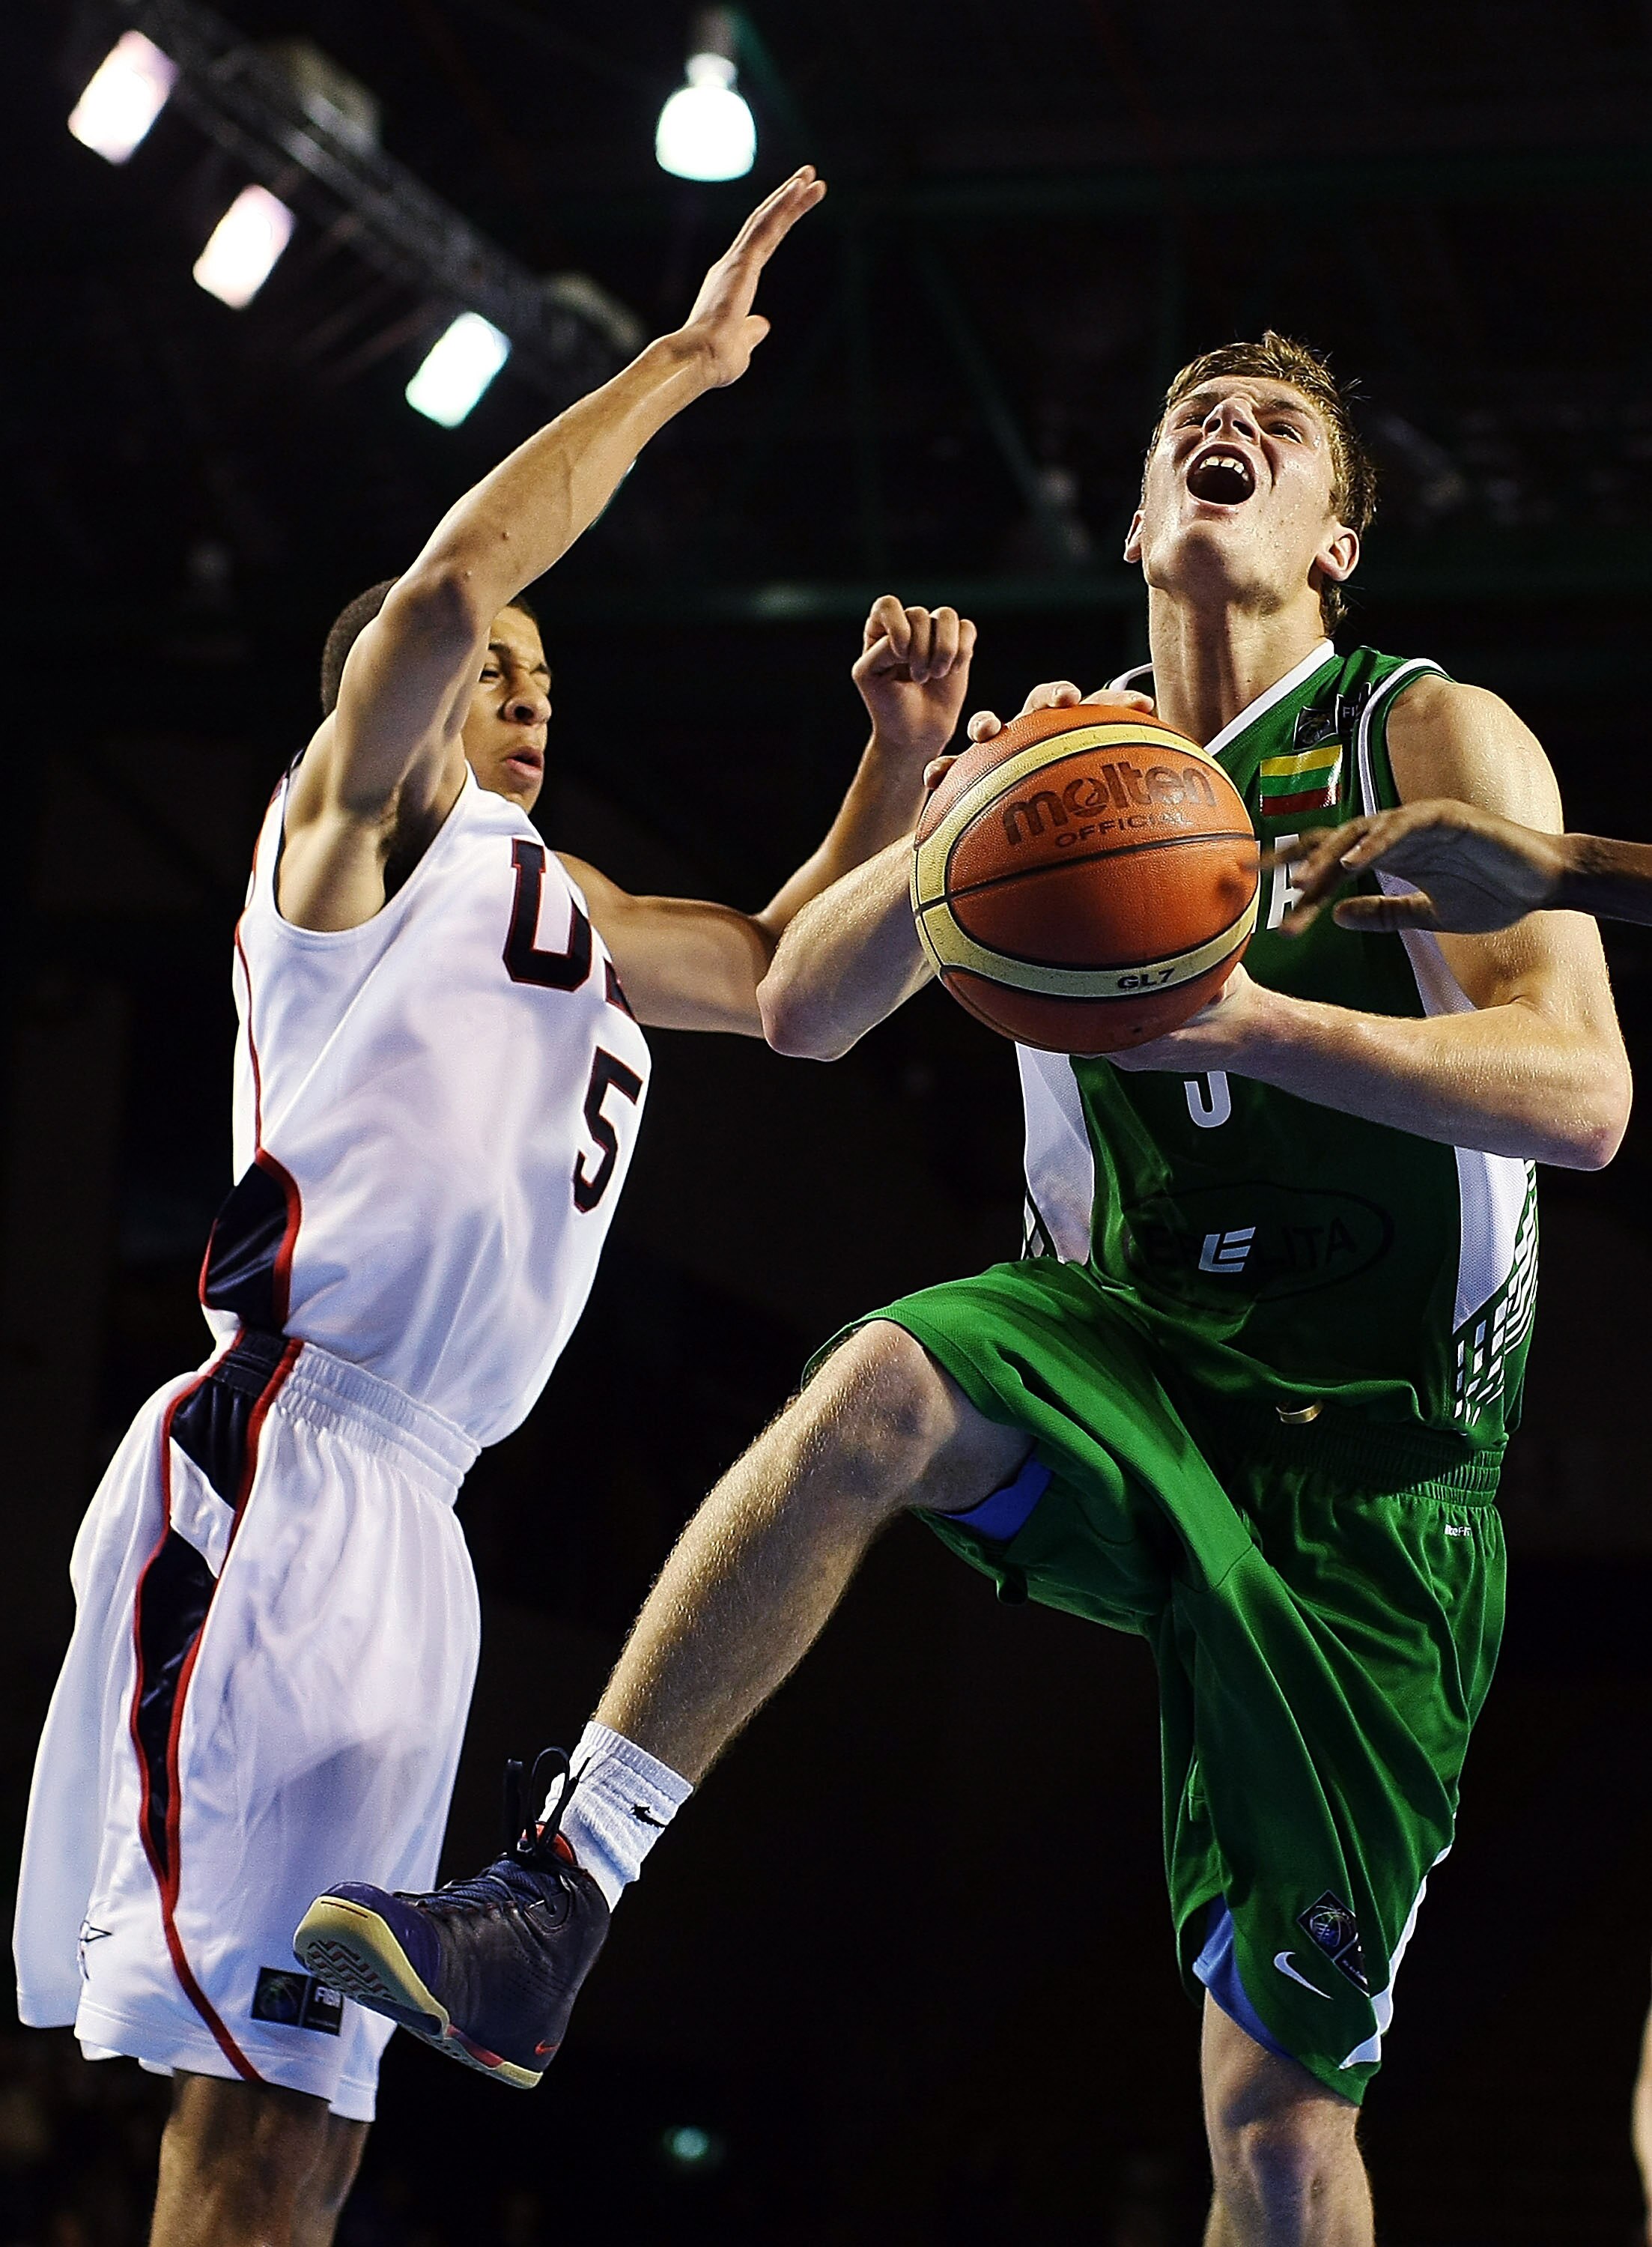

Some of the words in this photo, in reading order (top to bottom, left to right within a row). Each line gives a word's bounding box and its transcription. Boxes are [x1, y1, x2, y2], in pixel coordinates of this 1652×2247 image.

[1001, 760, 1218, 846] molten
[1054, 812, 1194, 848] OFFICIAL
[1117, 967, 1176, 990] GL7
[571, 1045, 644, 1214] 5
